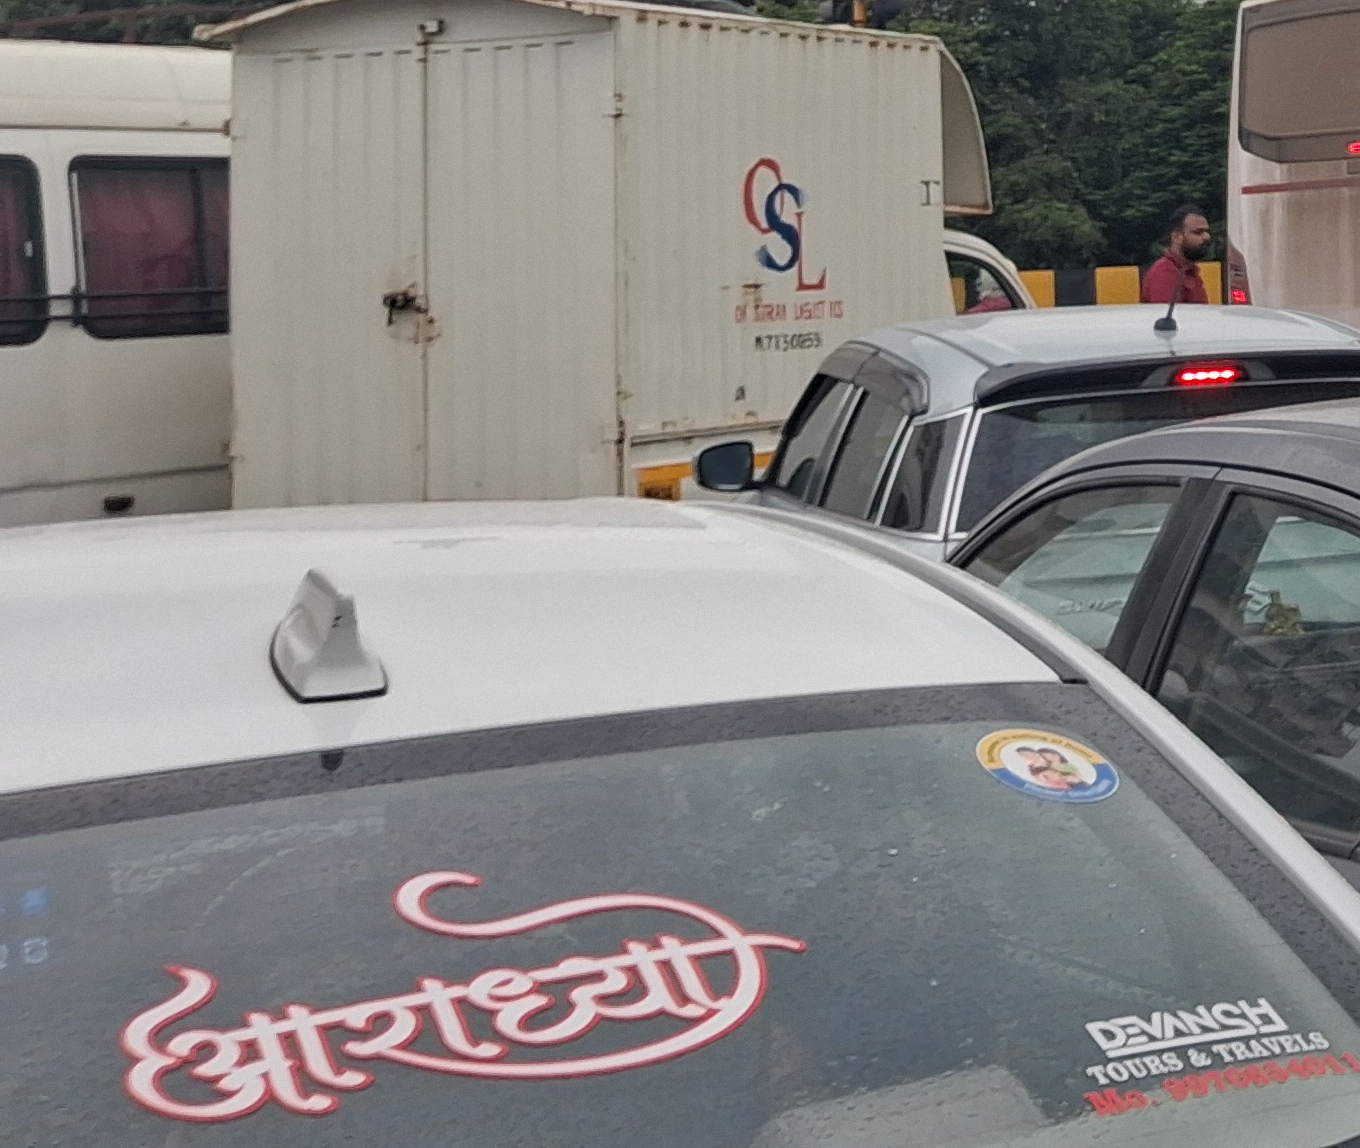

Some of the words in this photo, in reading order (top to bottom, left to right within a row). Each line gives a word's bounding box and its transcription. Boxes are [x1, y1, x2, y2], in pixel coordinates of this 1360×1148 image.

[120, 869, 807, 1122] आराध्या
[1086, 1051, 1184, 1086] TOURS
[1187, 1048, 1213, 1068] &
[1212, 1031, 1331, 1064] TRAVELS
